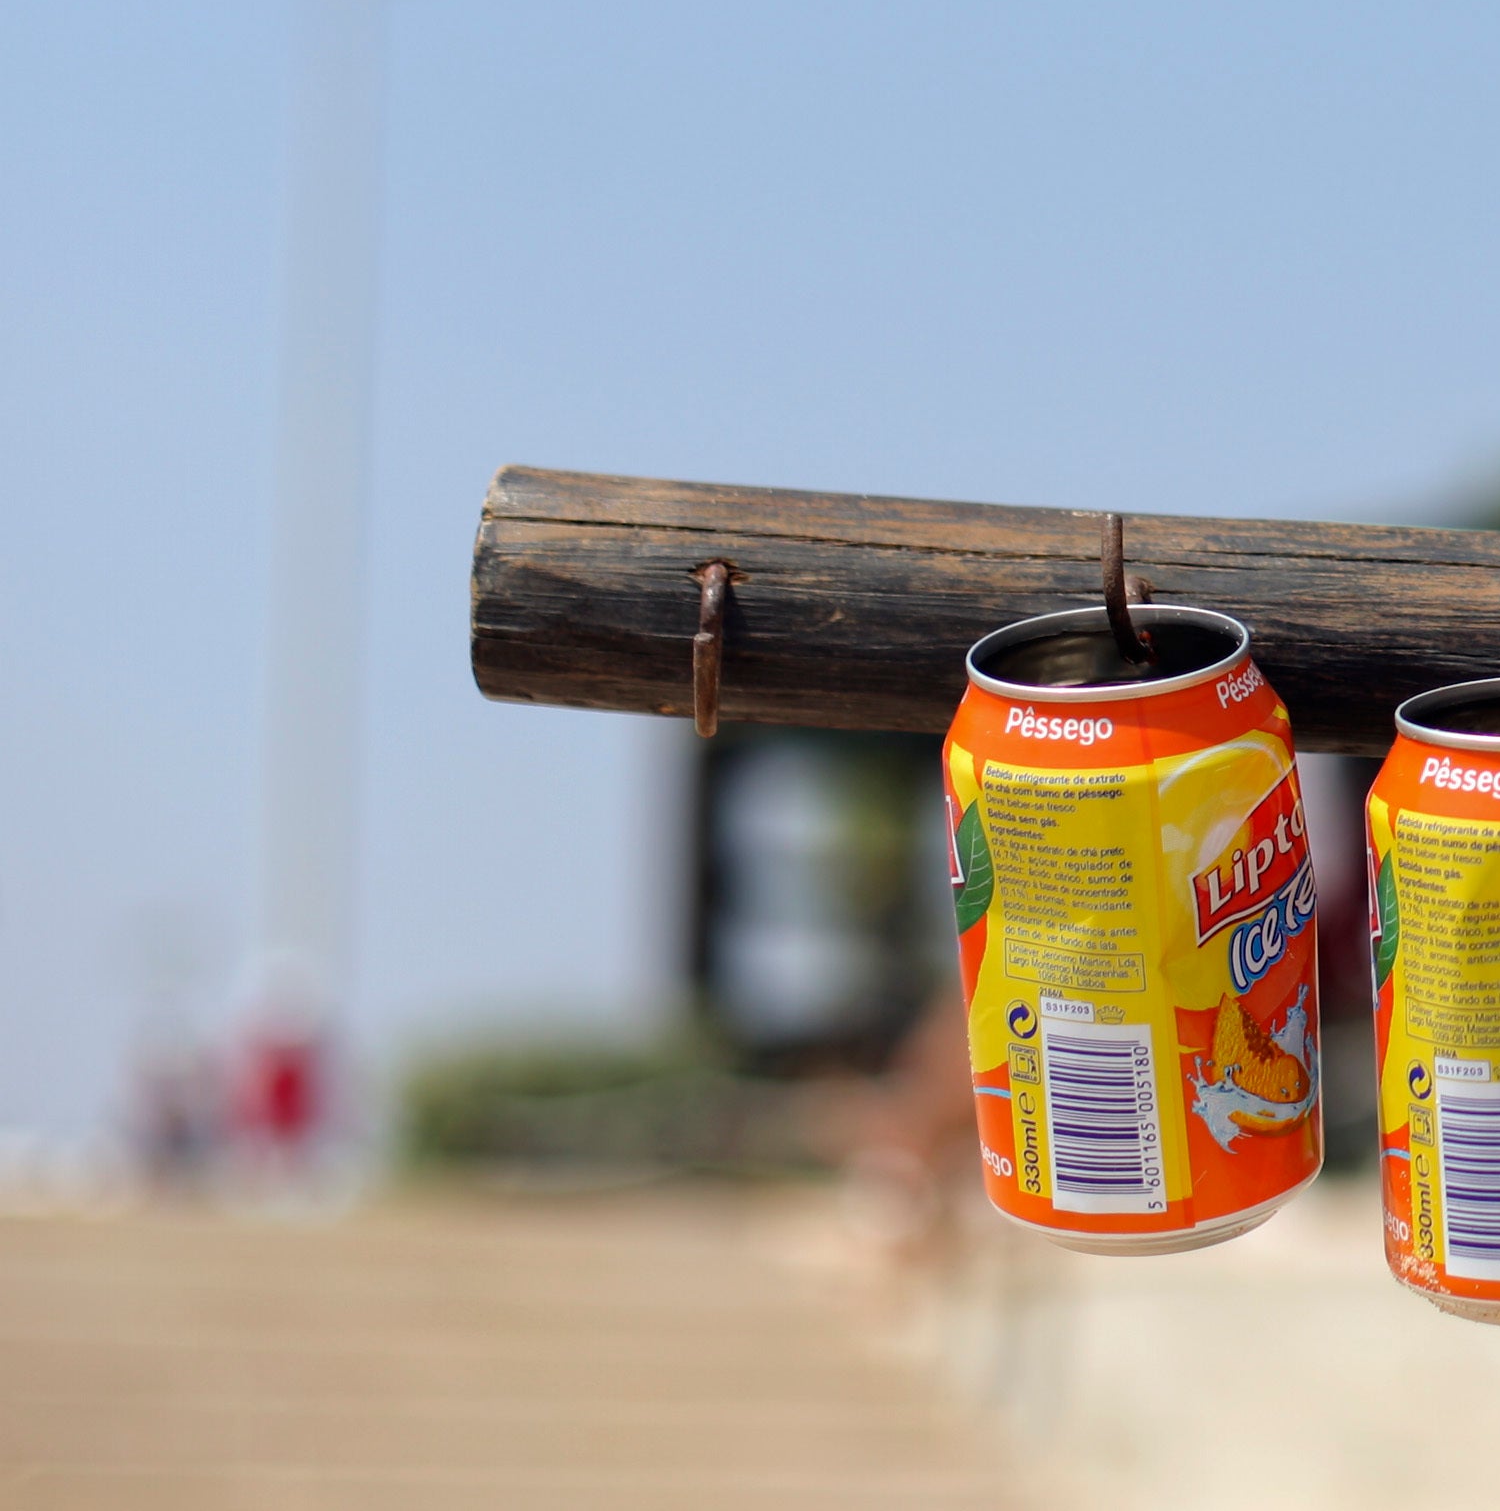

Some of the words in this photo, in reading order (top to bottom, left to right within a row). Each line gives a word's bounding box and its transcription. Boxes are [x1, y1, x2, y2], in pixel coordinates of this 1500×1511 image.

[1216, 659, 1264, 709] Pêsseg
[1004, 706, 1114, 746] Pêssego
[1014, 773, 1070, 786] refrigerante
[1073, 775, 1085, 785] de
[1088, 773, 1126, 785] extrato
[1207, 797, 1304, 915] Lipto
[1279, 854, 1316, 930] Te
[1231, 906, 1283, 988] Ice
[1021, 1119, 1041, 1193] 330ml
